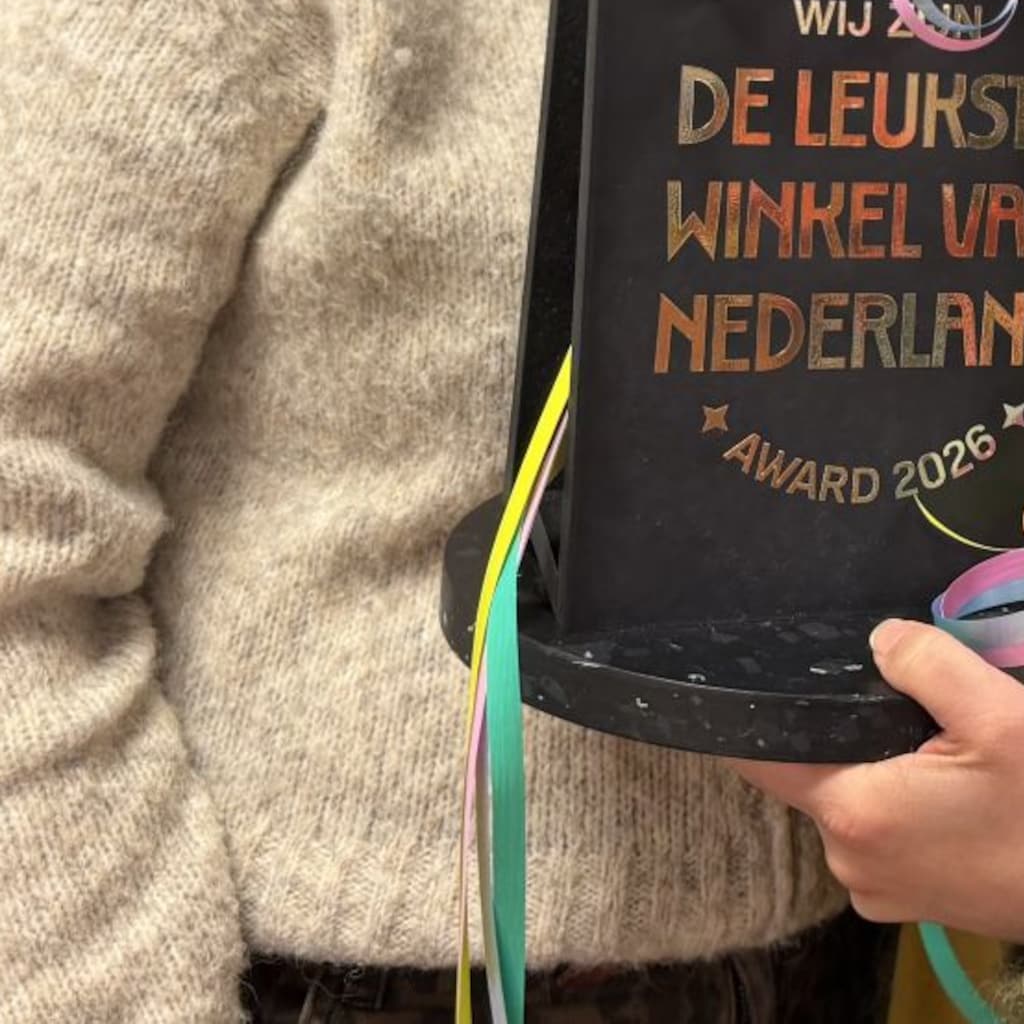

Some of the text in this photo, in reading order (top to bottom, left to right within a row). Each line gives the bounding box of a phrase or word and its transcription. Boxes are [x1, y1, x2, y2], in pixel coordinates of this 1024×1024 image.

[793, 0, 872, 37] WIJ
[678, 65, 775, 146] DE
[666, 180, 922, 262] WINKEL
[722, 424, 997, 505] AWARD 2026
